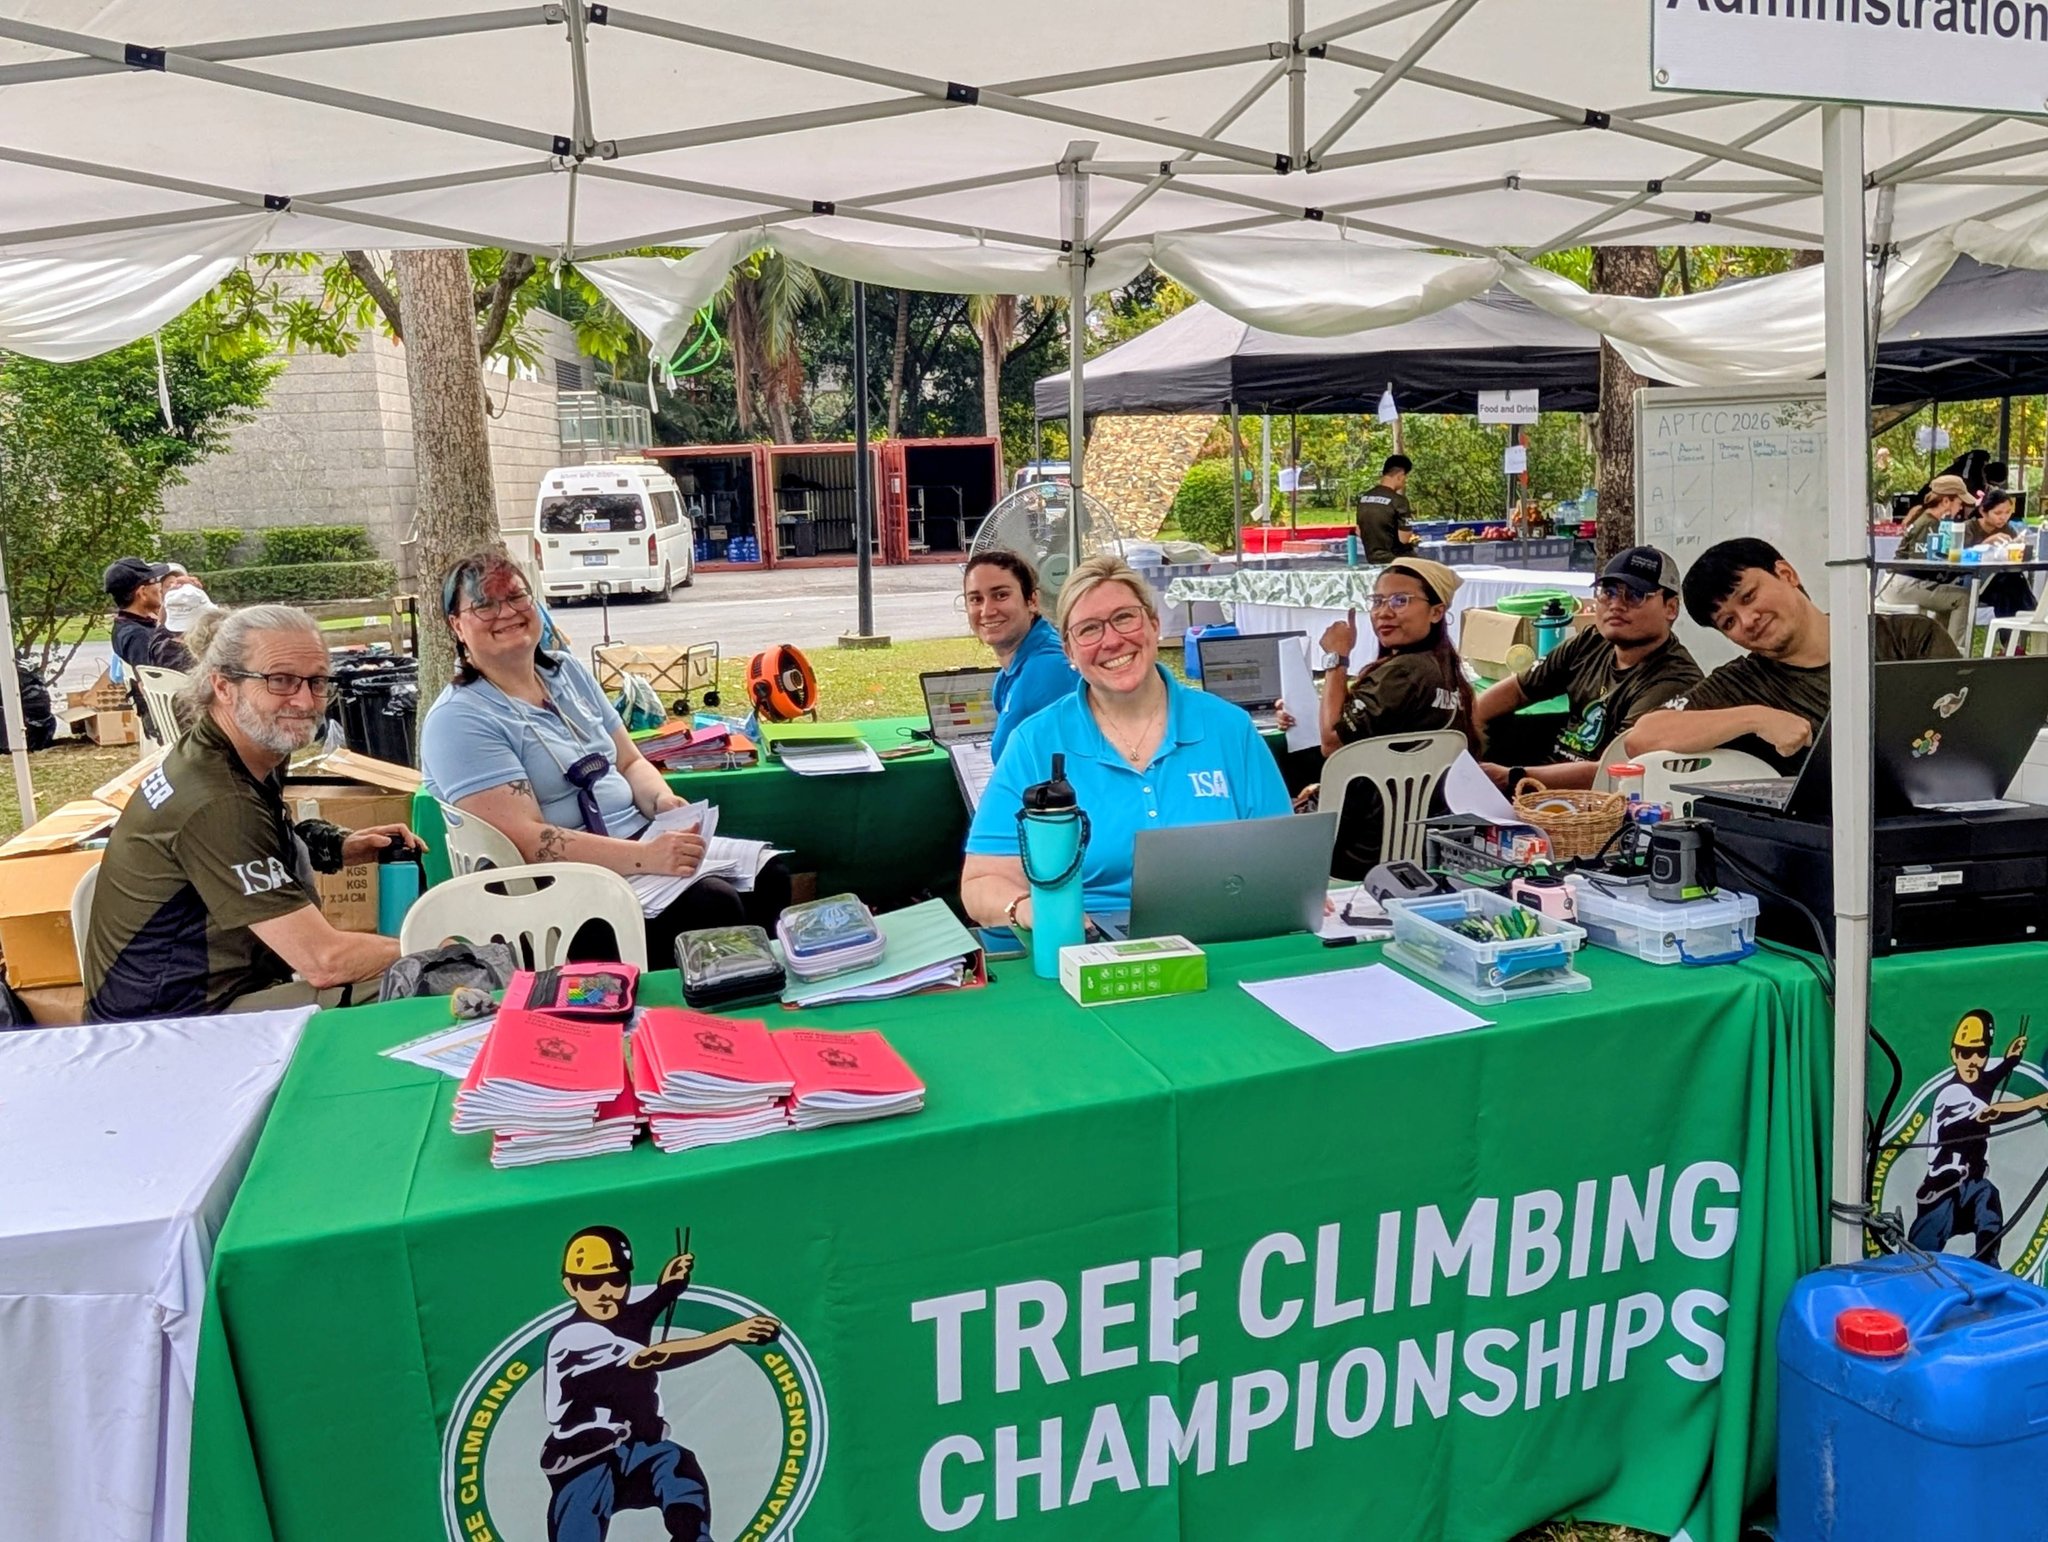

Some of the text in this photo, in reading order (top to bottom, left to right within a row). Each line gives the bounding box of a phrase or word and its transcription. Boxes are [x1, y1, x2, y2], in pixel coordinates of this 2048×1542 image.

[1666, 0, 2047, 41] stration
[1480, 404, 1537, 413] Food and Drink
[1652, 486, 1664, 501] A
[1654, 517, 1665, 532] B
[1187, 770, 1230, 798] ISA
[230, 856, 294, 896] ISA
[346, 866, 368, 877] KGS
[346, 879, 368, 890] KGS
[911, 1160, 1741, 1405] TREE CLIMBING
[918, 1289, 1731, 1533] CHAMPIONSHIPS
[461, 1361, 529, 1505] CLIMBING
